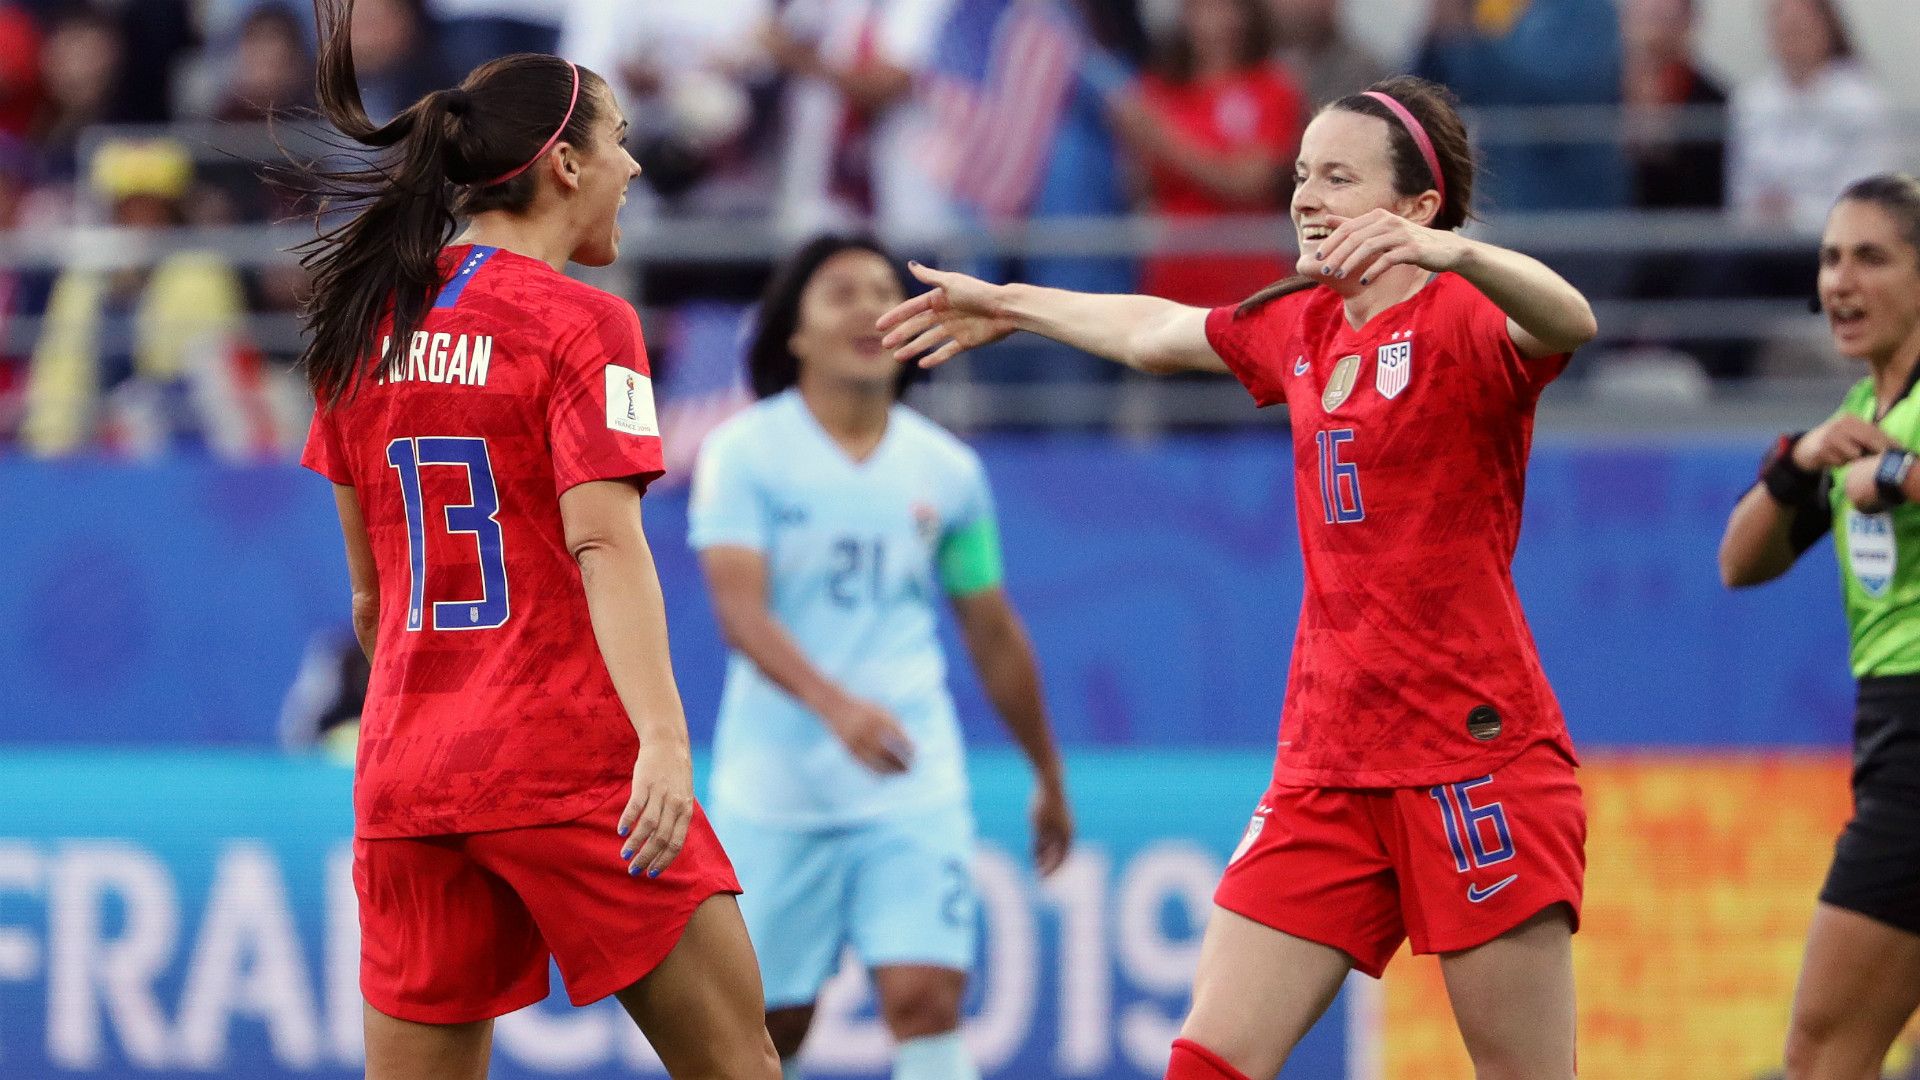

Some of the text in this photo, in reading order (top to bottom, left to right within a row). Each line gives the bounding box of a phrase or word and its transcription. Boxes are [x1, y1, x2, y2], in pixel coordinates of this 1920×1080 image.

[1380, 345, 1408, 368] USA
[1316, 428, 1366, 525] 16
[386, 436, 510, 631] 13
[830, 535, 885, 608] 21
[1429, 774, 1516, 873] 16
